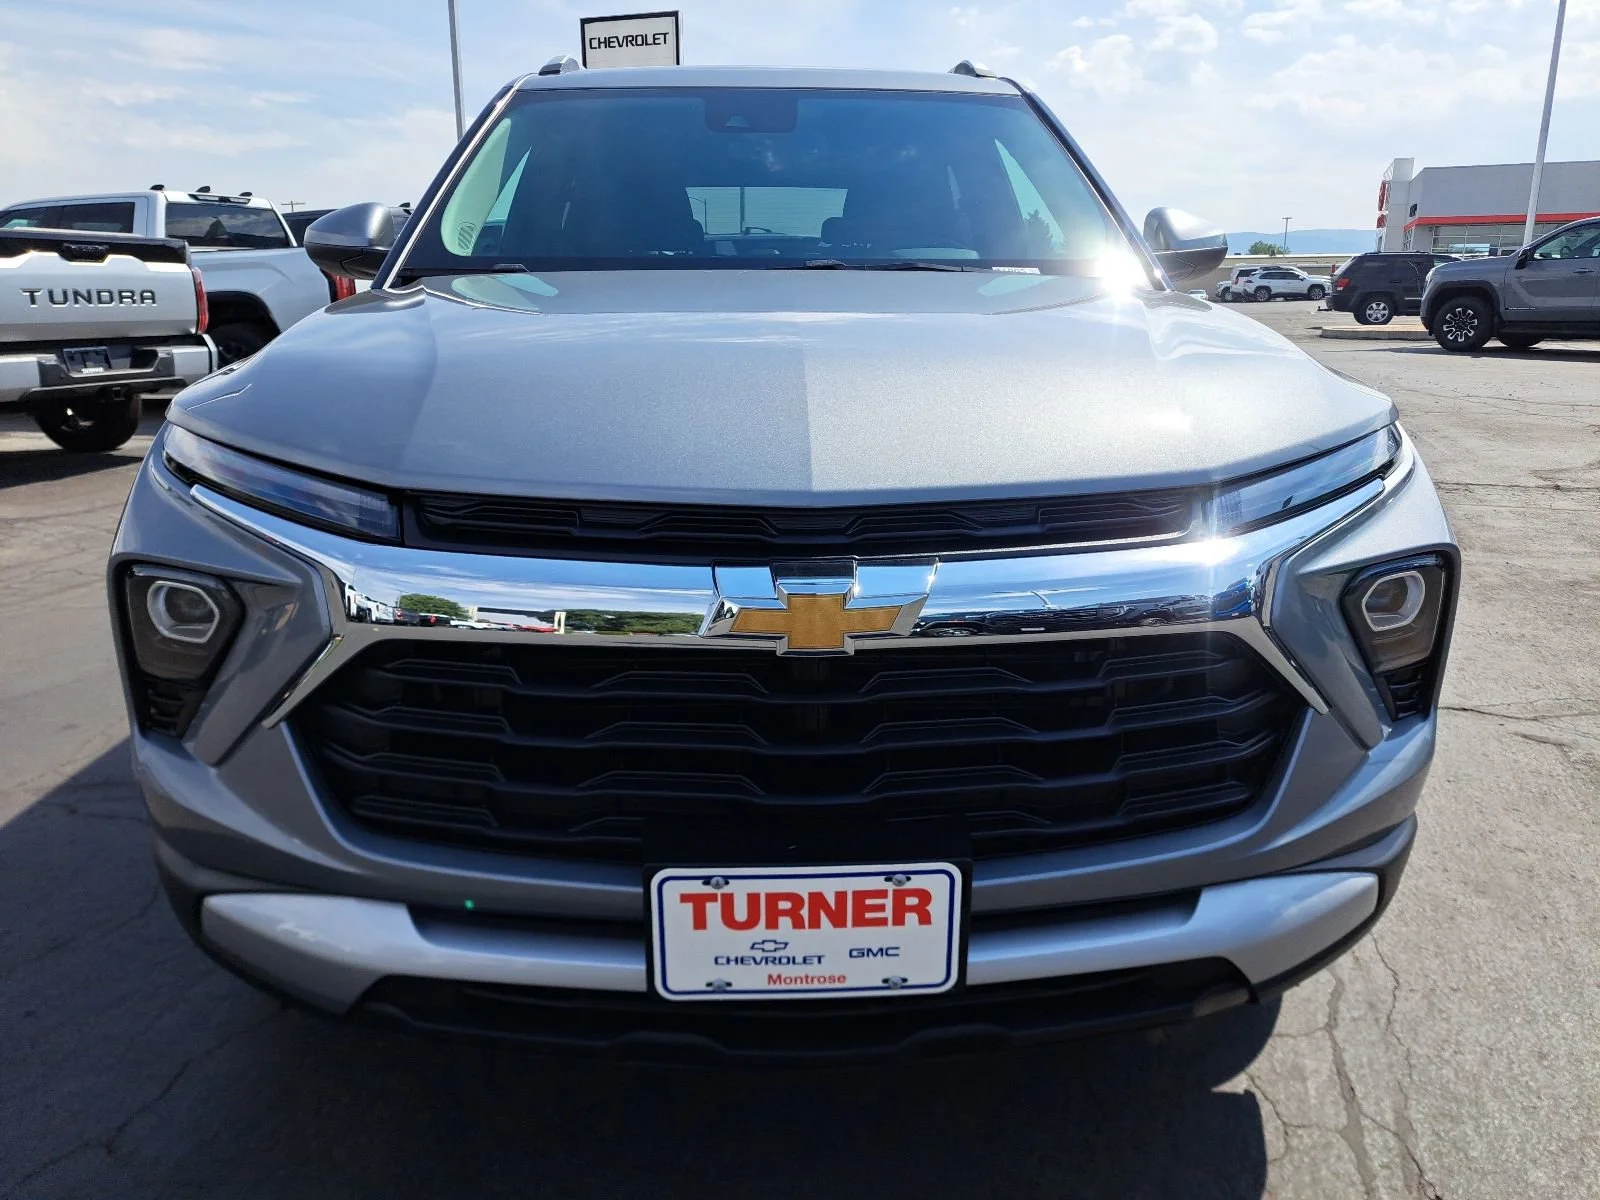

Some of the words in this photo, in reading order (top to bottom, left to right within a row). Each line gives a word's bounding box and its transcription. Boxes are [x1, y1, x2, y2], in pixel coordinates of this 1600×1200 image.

[589, 32, 669, 50] CHEVROLET
[20, 288, 157, 307] TUNDRA
[679, 887, 933, 931] TURNER
[849, 946, 900, 958] GMC
[714, 954, 825, 966] CHEVROLET
[767, 973, 847, 986] Montrose
